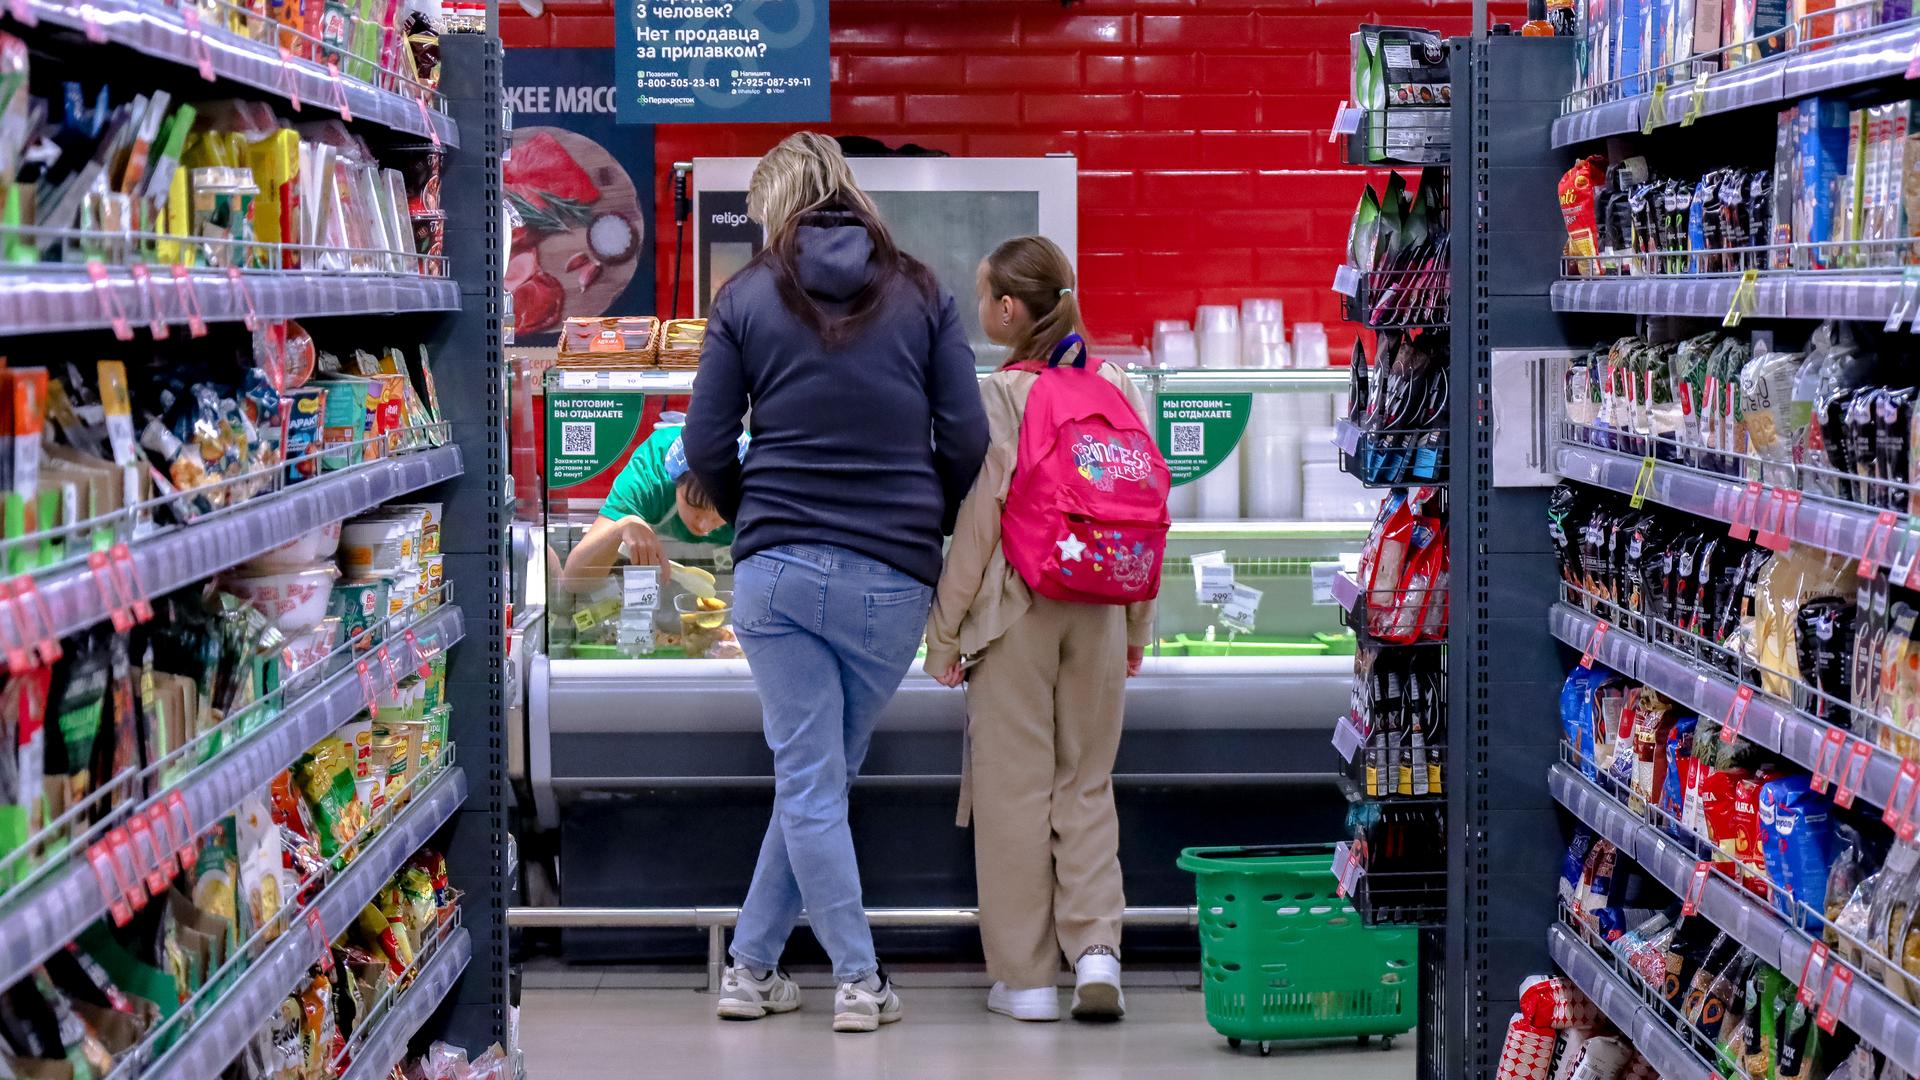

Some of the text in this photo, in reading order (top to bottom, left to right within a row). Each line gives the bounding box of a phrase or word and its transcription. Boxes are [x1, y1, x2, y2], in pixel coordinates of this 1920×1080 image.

[636, 4, 733, 18] 3 человек?
[636, 26, 760, 44] Нет продавца
[637, 43, 767, 61] за прилавком?
[637, 79, 720, 88] 8-800-505-23-81
[731, 78, 811, 87] +7-925-087-59-11
[711, 211, 748, 227] retigo
[554, 400, 570, 408] МЫ
[571, 400, 614, 408] ГОТОВИМ
[554, 410, 623, 419] ВЫ ОТДЫХАЕТЕ
[1163, 410, 1232, 419] ВЫ ОТДЫХАЕТЕ
[641, 594, 652, 602] 49
[1212, 592, 1228, 601] 299
